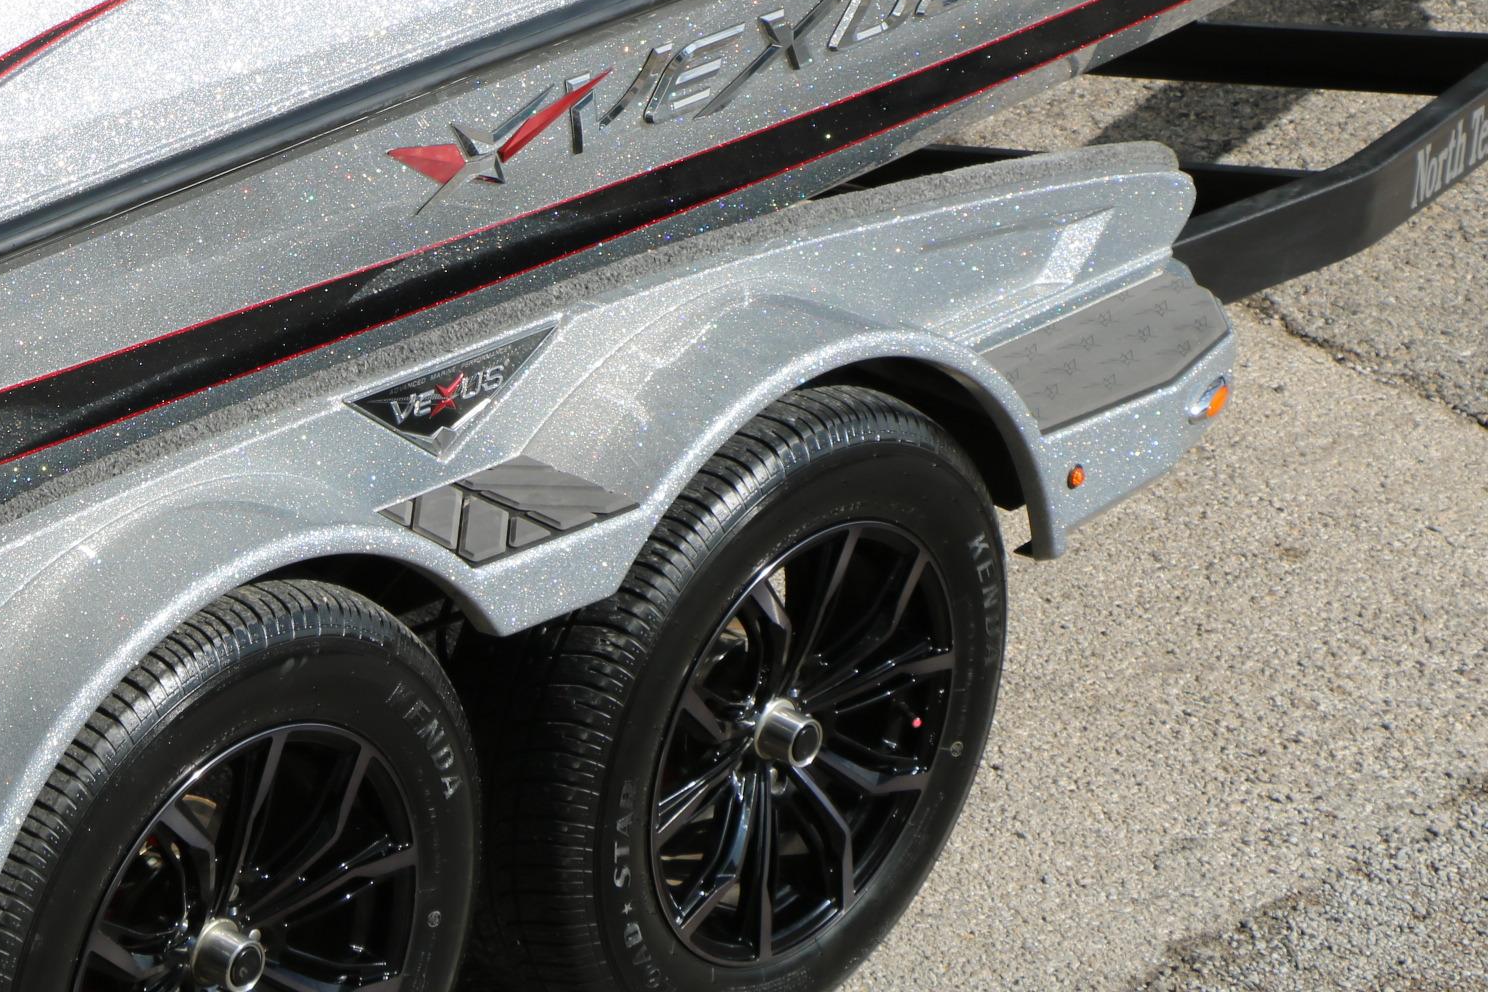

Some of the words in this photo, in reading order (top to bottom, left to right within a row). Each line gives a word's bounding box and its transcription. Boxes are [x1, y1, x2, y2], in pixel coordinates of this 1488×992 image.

[1410, 119, 1468, 210] North
[1468, 104, 1488, 167] Te
[388, 364, 506, 426] VEXUS
[968, 532, 1003, 667] KENDA
